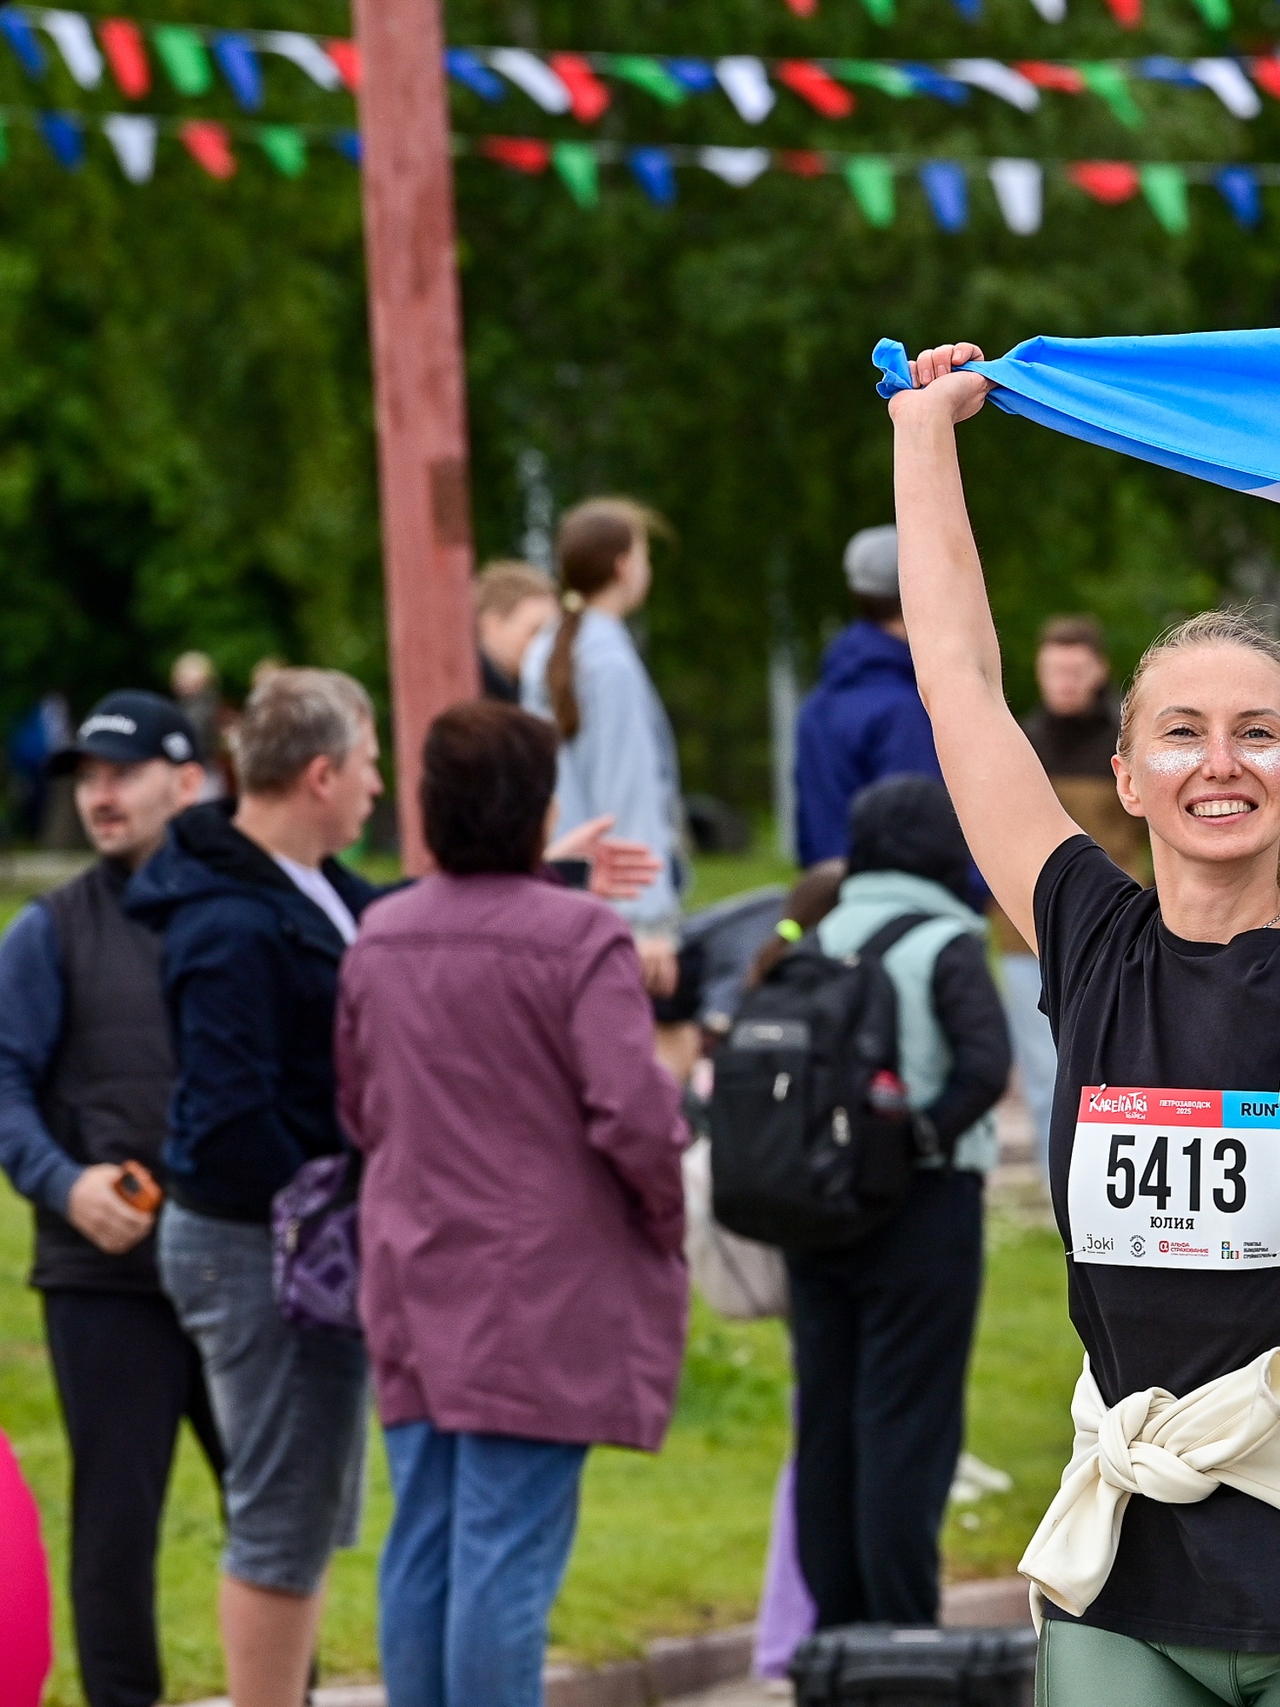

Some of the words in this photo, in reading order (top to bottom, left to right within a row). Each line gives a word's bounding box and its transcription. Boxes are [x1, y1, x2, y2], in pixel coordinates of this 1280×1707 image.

[1159, 1099, 1212, 1109] ПЕТРОЗАВОДСК
[1176, 1107, 1192, 1115] 2025
[1106, 1134, 1247, 1213] 5413
[1150, 1216, 1195, 1230] ЮЛИЯ
